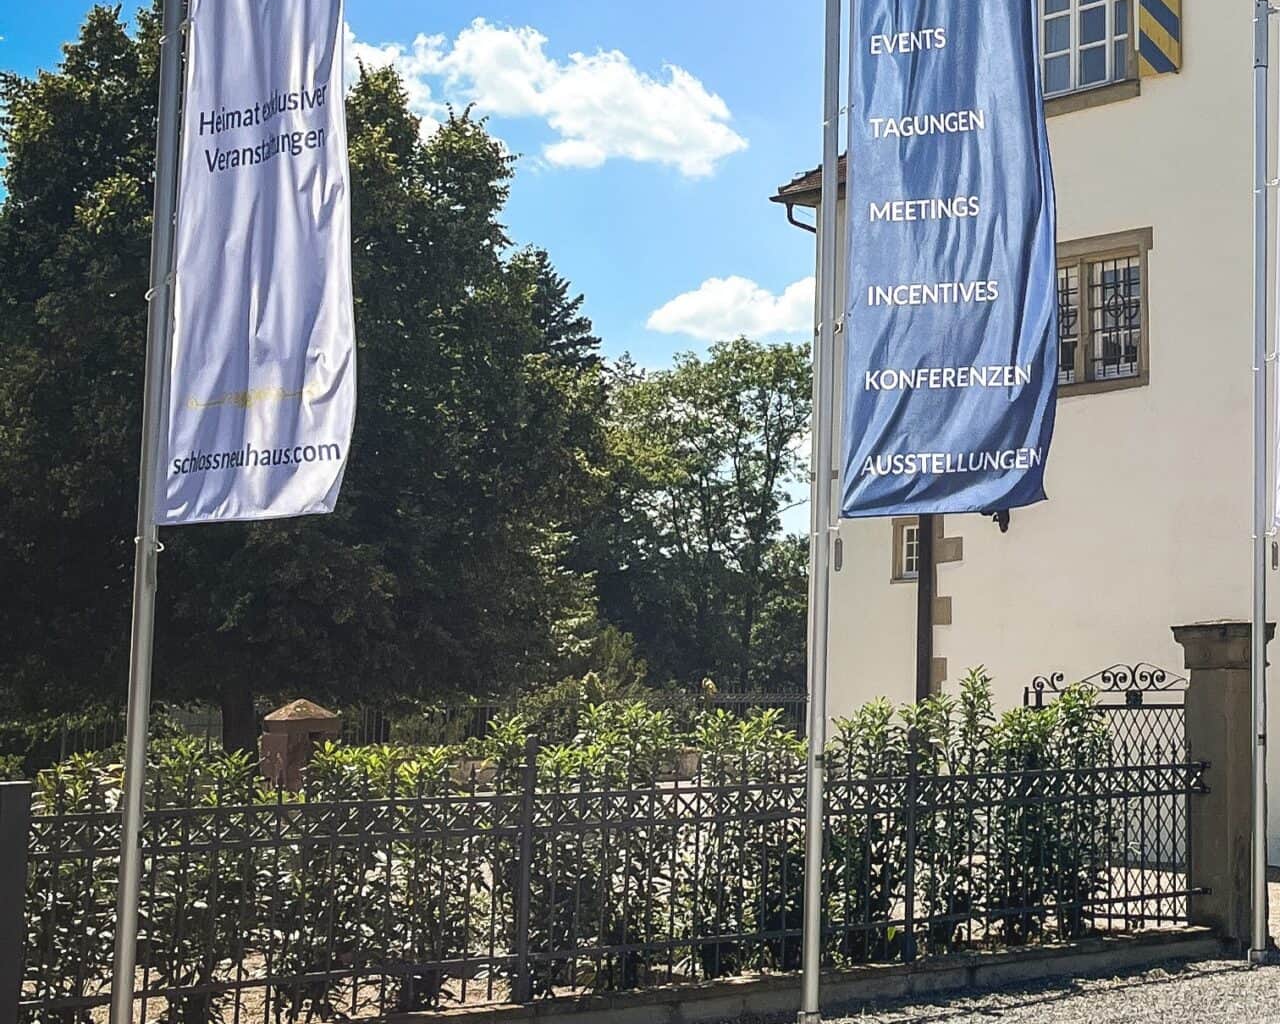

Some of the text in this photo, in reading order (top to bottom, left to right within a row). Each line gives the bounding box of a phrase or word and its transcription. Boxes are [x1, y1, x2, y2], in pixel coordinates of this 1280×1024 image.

[870, 28, 946, 55] EVENTS
[199, 102, 260, 136] Heimat
[870, 108, 985, 138] TAGUNGEN
[869, 196, 980, 222] MEETINGS
[867, 280, 999, 306] INCENTIVES
[864, 364, 1032, 391] KONFERENZEN
[173, 441, 341, 475] schlossneuhaus.com
[860, 447, 1042, 477] AUSSTELLUNGEN
